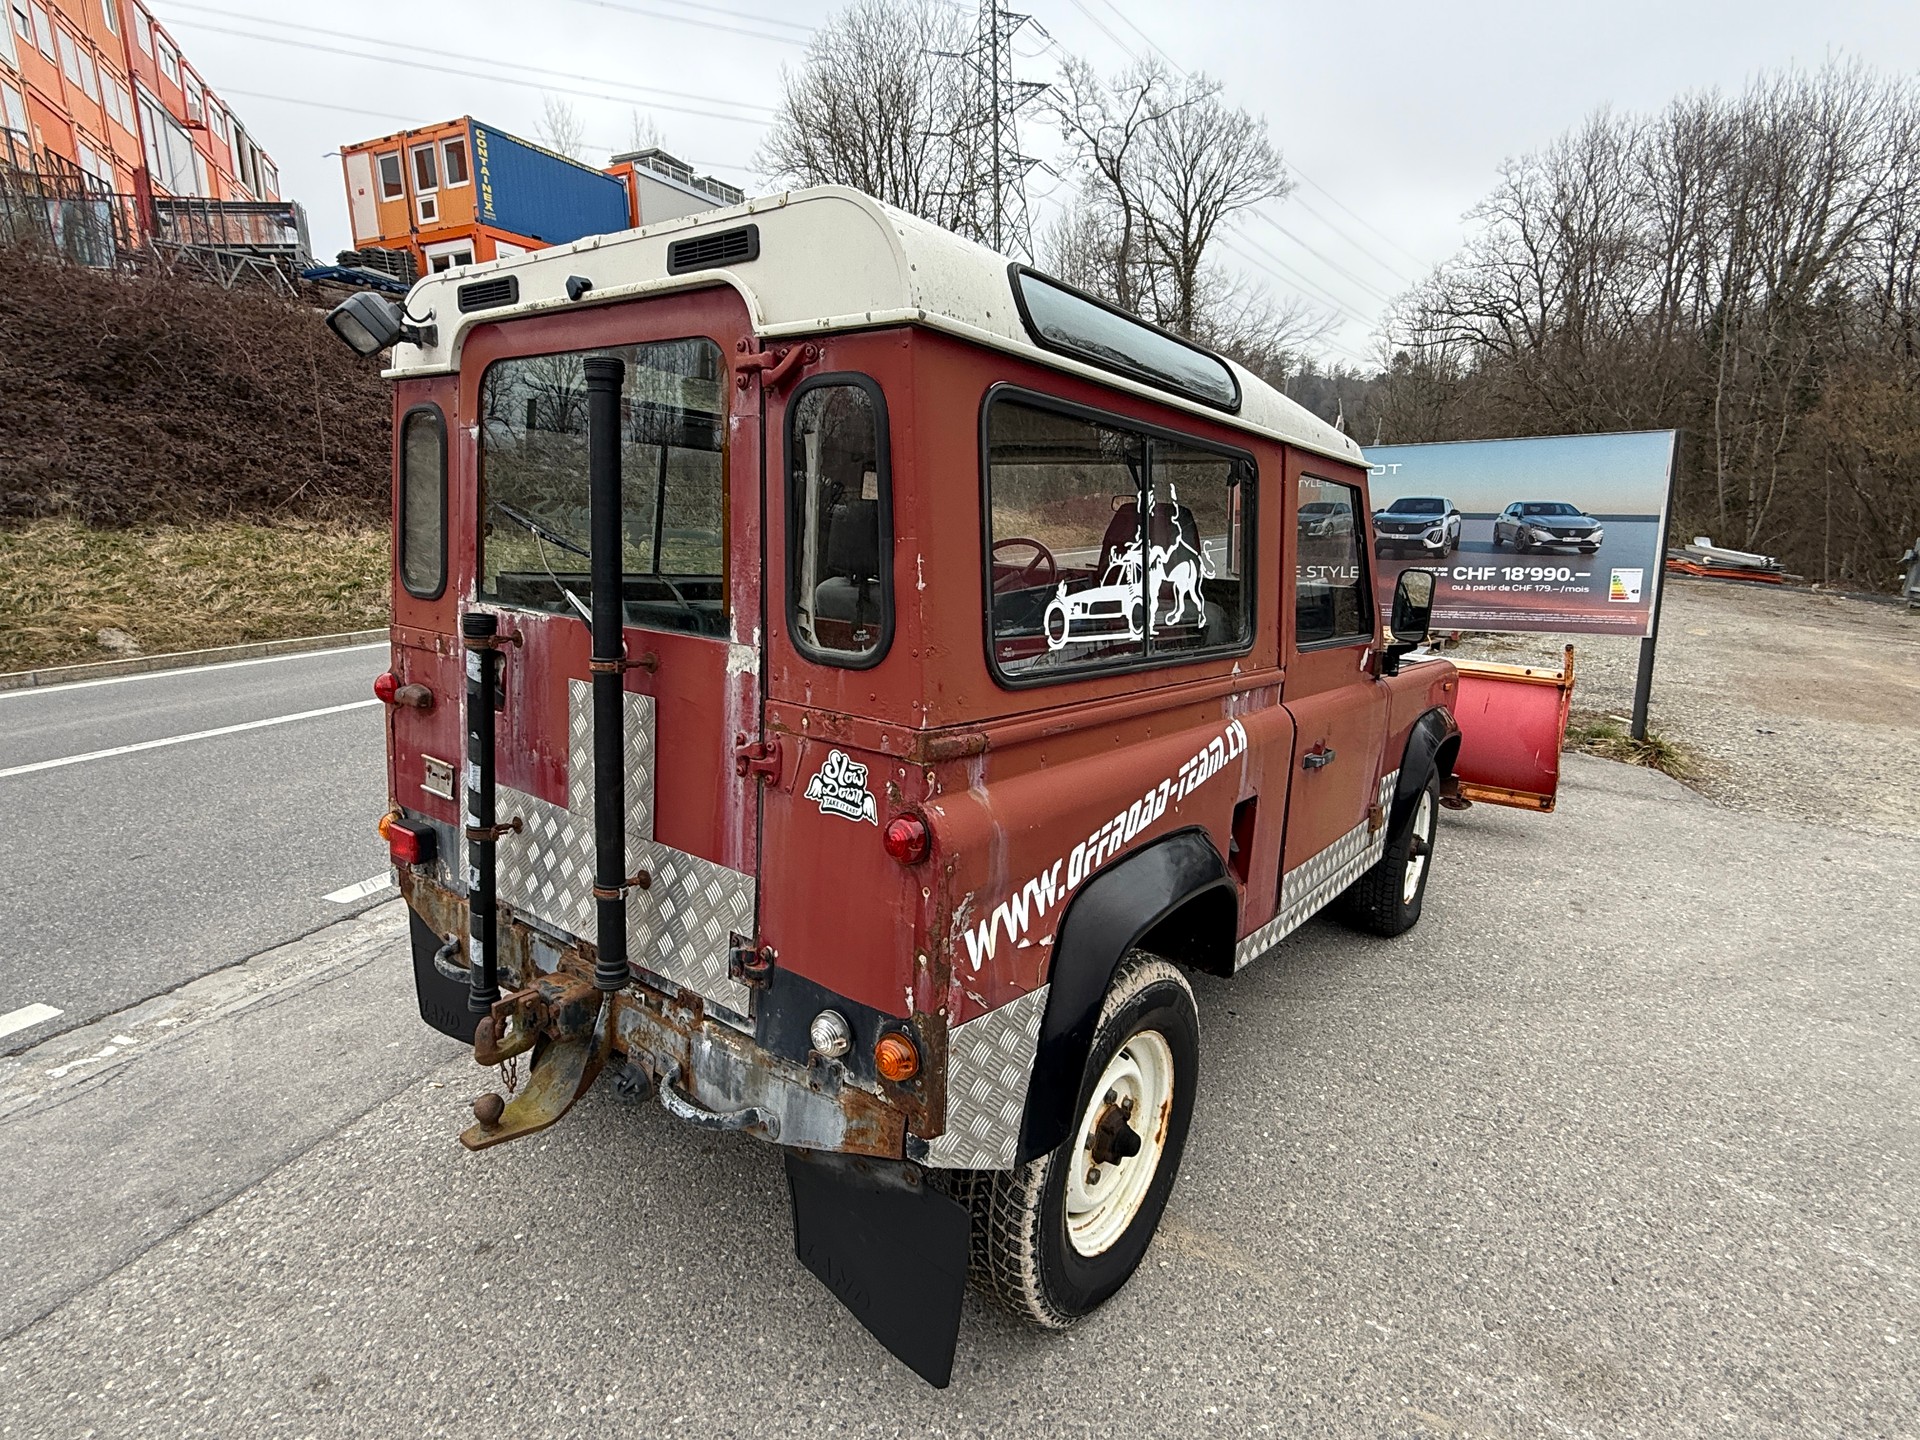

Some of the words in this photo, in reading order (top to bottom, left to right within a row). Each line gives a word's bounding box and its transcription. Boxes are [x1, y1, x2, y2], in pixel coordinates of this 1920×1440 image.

[475, 128, 494, 211] CONTAINEX
[1306, 565, 1359, 578] STYLE
[1453, 566, 1497, 581] CHF
[1472, 584, 1497, 592] partir
[1498, 584, 1510, 592] de
[1511, 584, 1532, 592] CHF
[824, 751, 865, 786] Slow
[822, 775, 863, 806] Down
[825, 797, 839, 807] TAKE
[840, 802, 846, 810] IT
[845, 805, 859, 815] EASY
